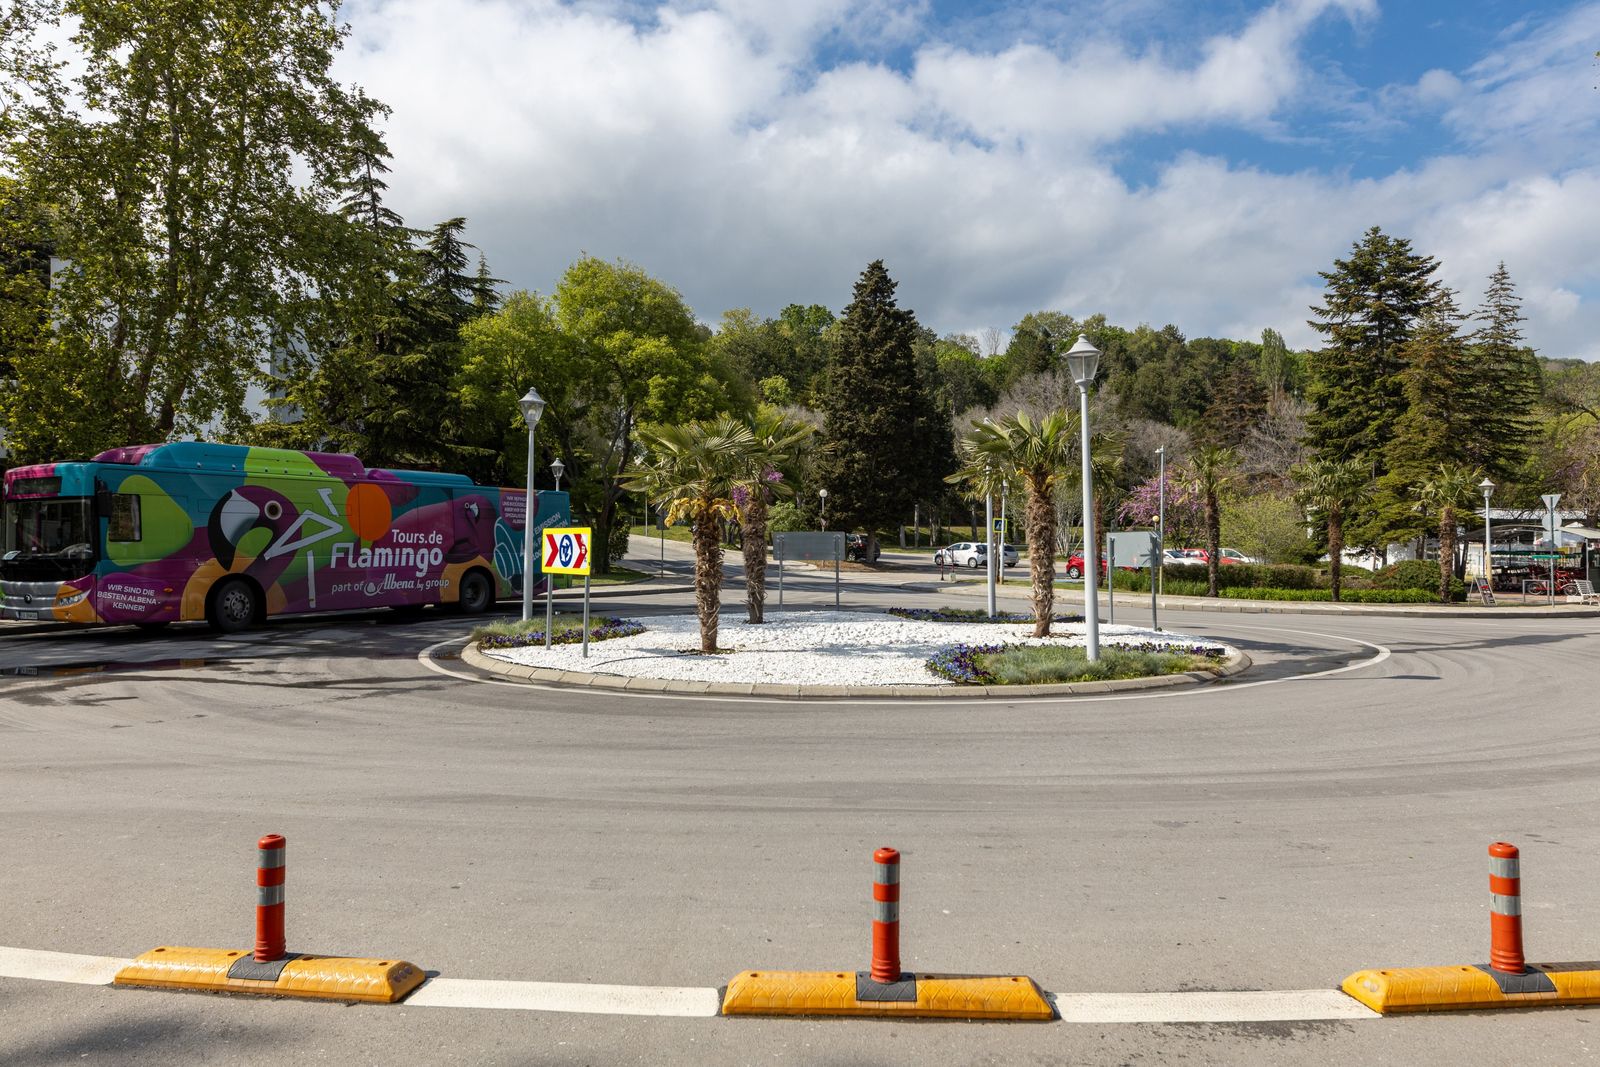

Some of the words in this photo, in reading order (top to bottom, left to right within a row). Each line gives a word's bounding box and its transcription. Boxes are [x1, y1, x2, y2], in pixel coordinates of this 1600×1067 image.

[534, 511, 561, 535] EMISSION
[391, 529, 443, 545] Tours.de
[330, 542, 443, 577] Flamingo
[107, 583, 123, 592] WIR
[123, 586, 142, 594] SIND
[142, 588, 155, 596] DIE
[331, 583, 352, 595] part
[353, 581, 364, 591] of
[377, 573, 415, 591] Albena
[416, 579, 424, 591] by
[425, 579, 449, 590] group
[97, 591, 127, 601] BESTEN
[112, 601, 145, 612] KENNER!
